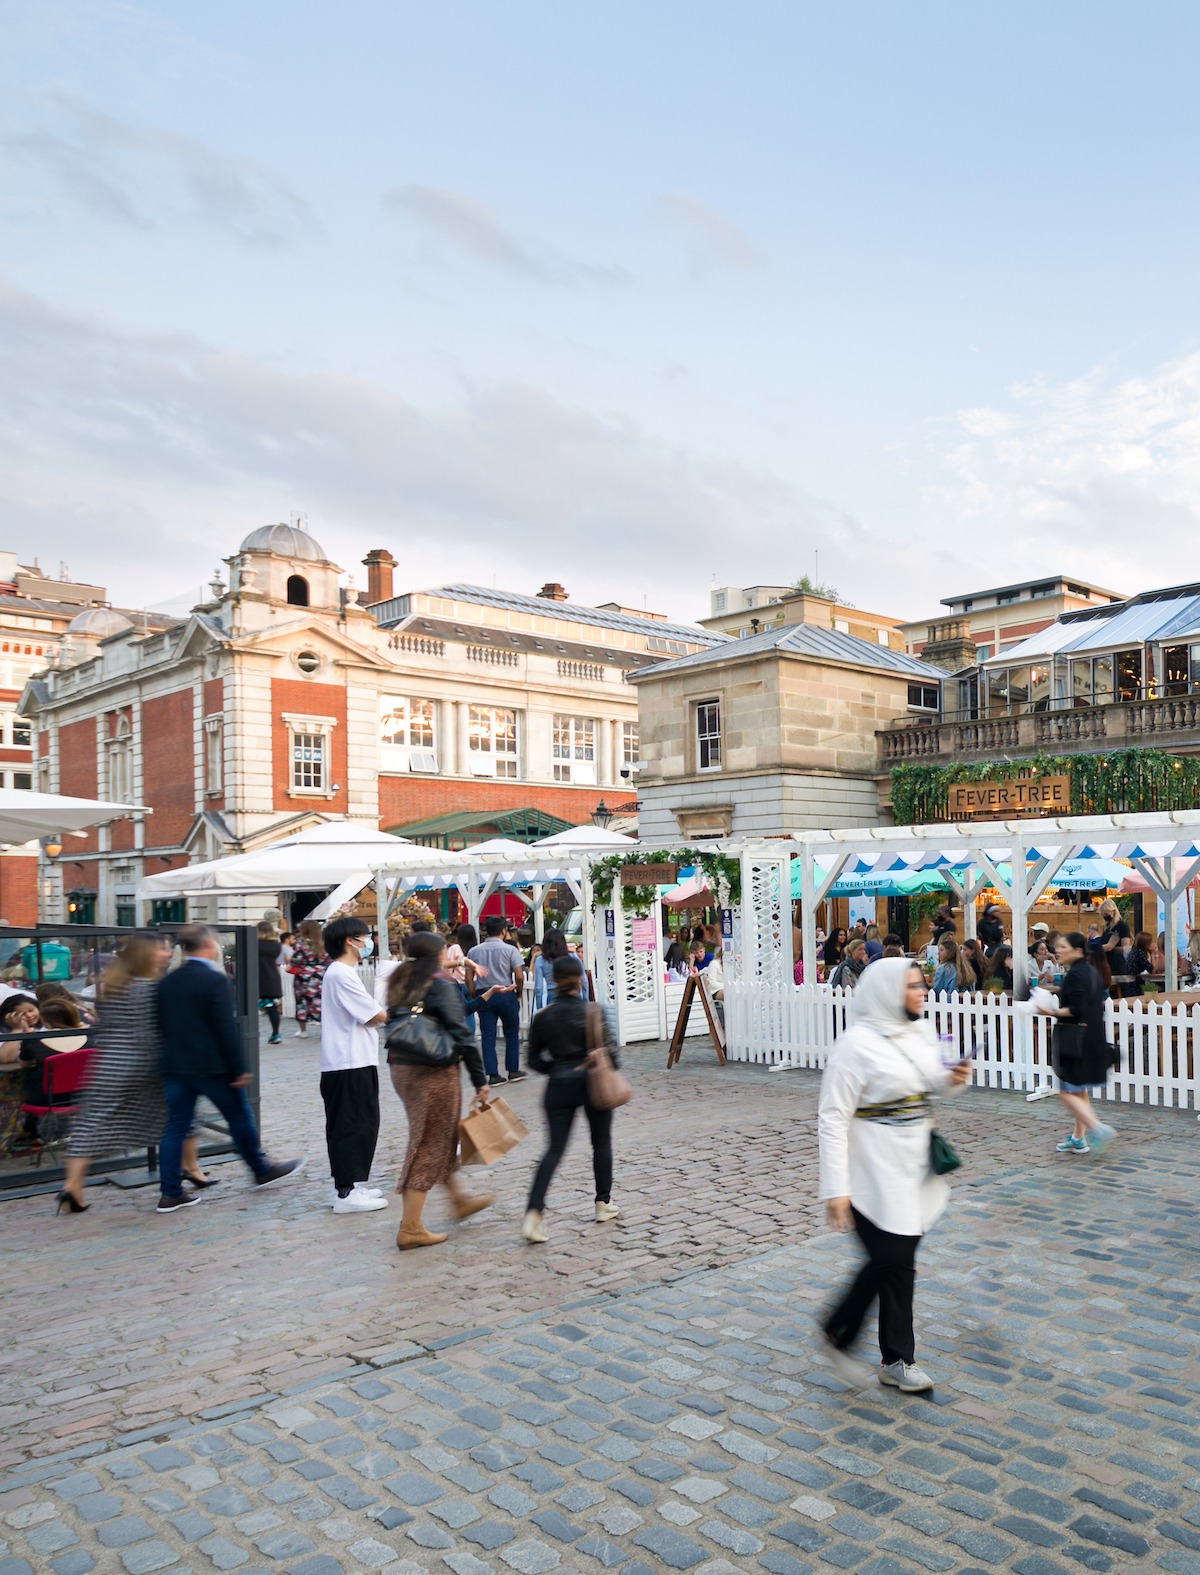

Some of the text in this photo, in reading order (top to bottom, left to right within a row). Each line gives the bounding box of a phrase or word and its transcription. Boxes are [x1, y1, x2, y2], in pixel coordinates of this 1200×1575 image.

[295, 750, 321, 760] GYM
[956, 784, 1062, 806] FEVER-TREE
[624, 869, 671, 880] FEVER-TREE
[835, 879, 883, 888] FEVER-TREE
